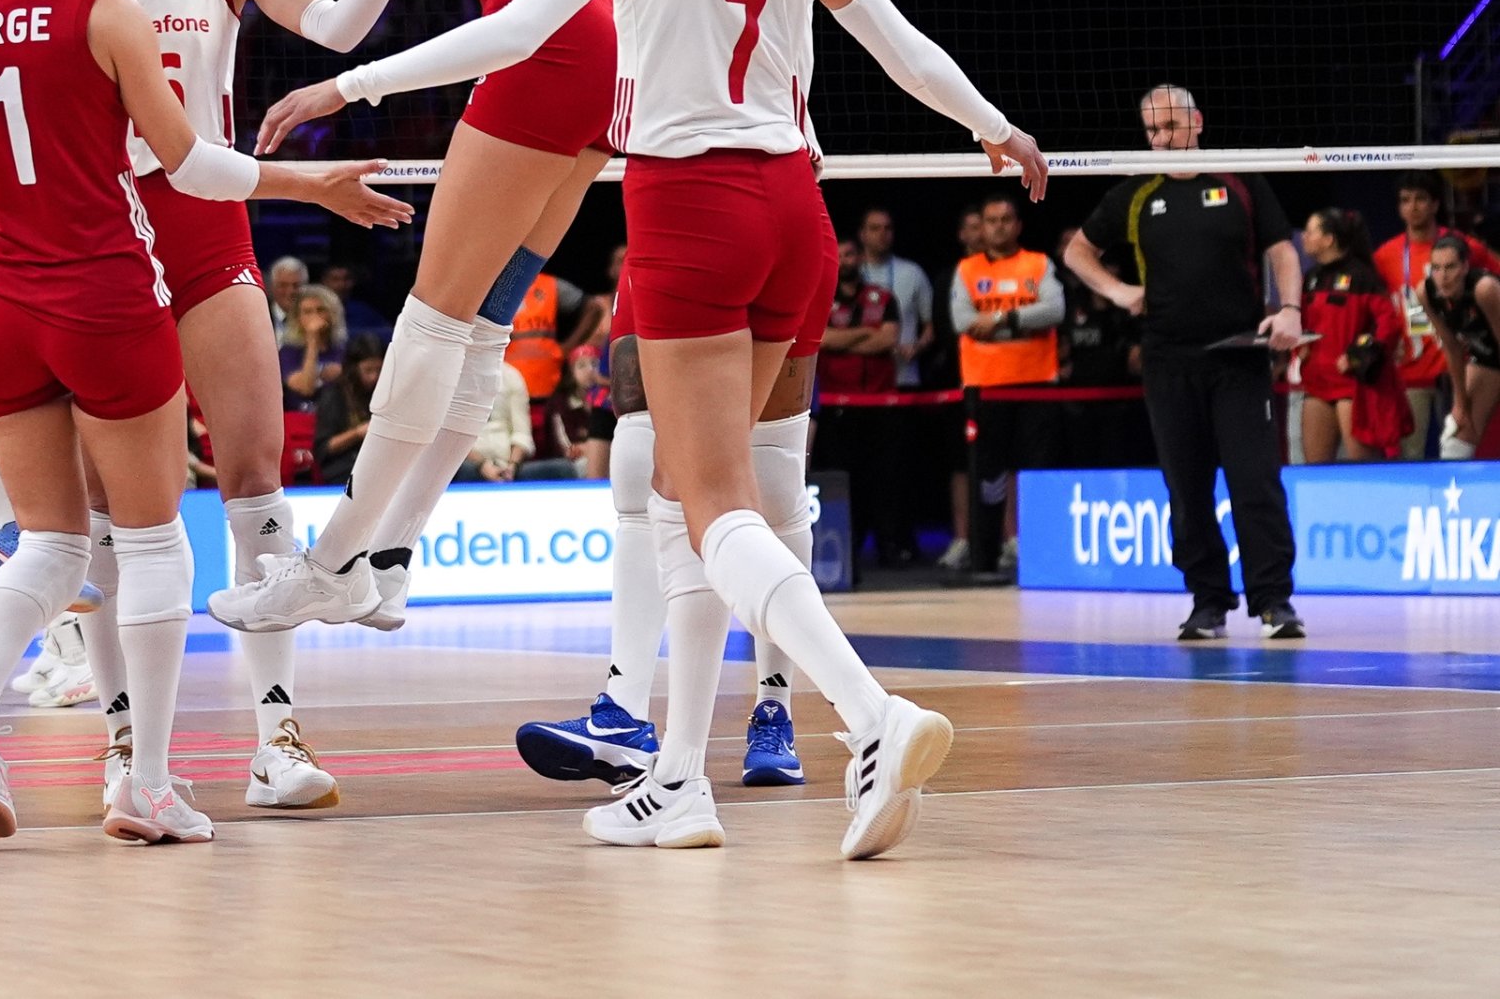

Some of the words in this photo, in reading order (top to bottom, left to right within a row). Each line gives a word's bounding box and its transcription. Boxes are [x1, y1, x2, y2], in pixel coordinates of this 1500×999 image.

[152, 14, 209, 34] afone
[1048, 158, 1090, 167] EYBALL
[1325, 154, 1393, 163] VOLLEYBALL
